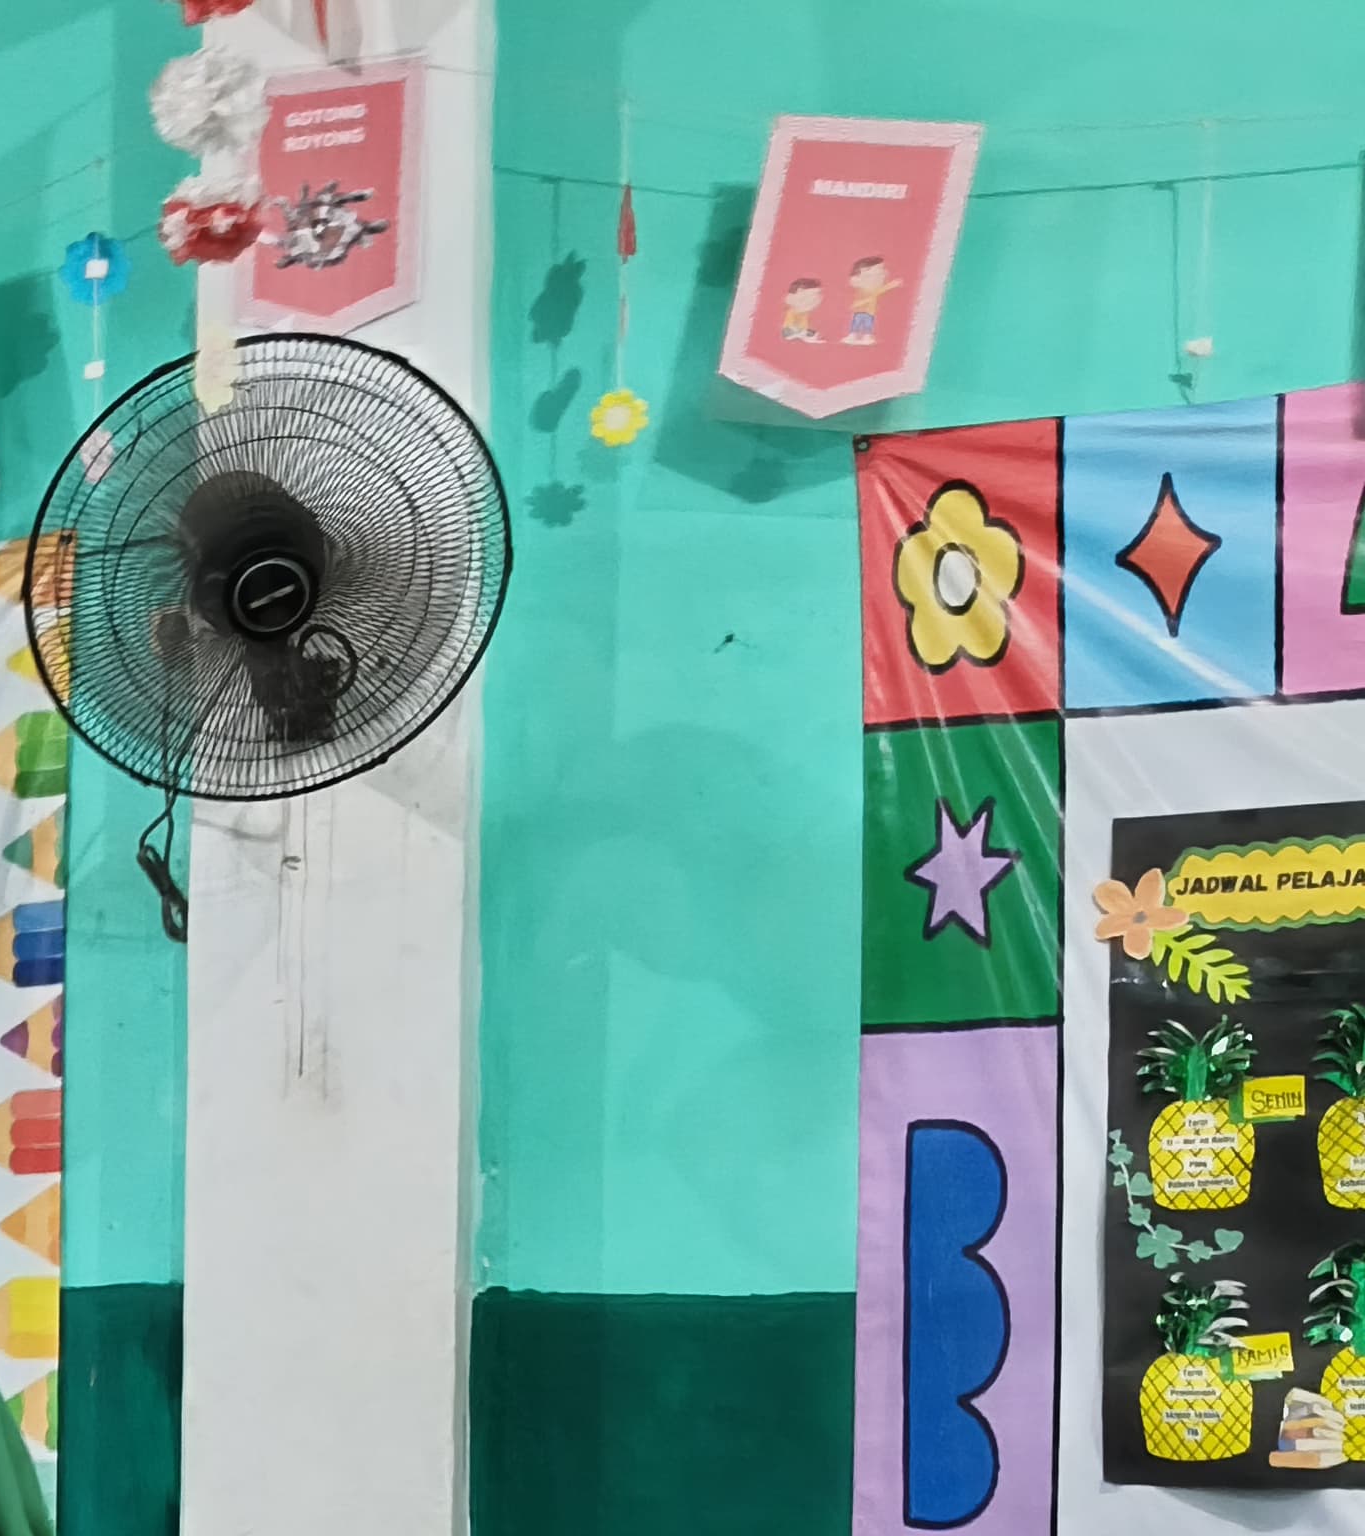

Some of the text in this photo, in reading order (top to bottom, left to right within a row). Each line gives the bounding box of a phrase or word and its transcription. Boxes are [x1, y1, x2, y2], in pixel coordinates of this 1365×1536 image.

[285, 103, 367, 128] GOTONG
[283, 127, 365, 152] ROYONG
[811, 179, 908, 199] MANDIRI
[1175, 868, 1365, 896] JADWAL PELAJA
